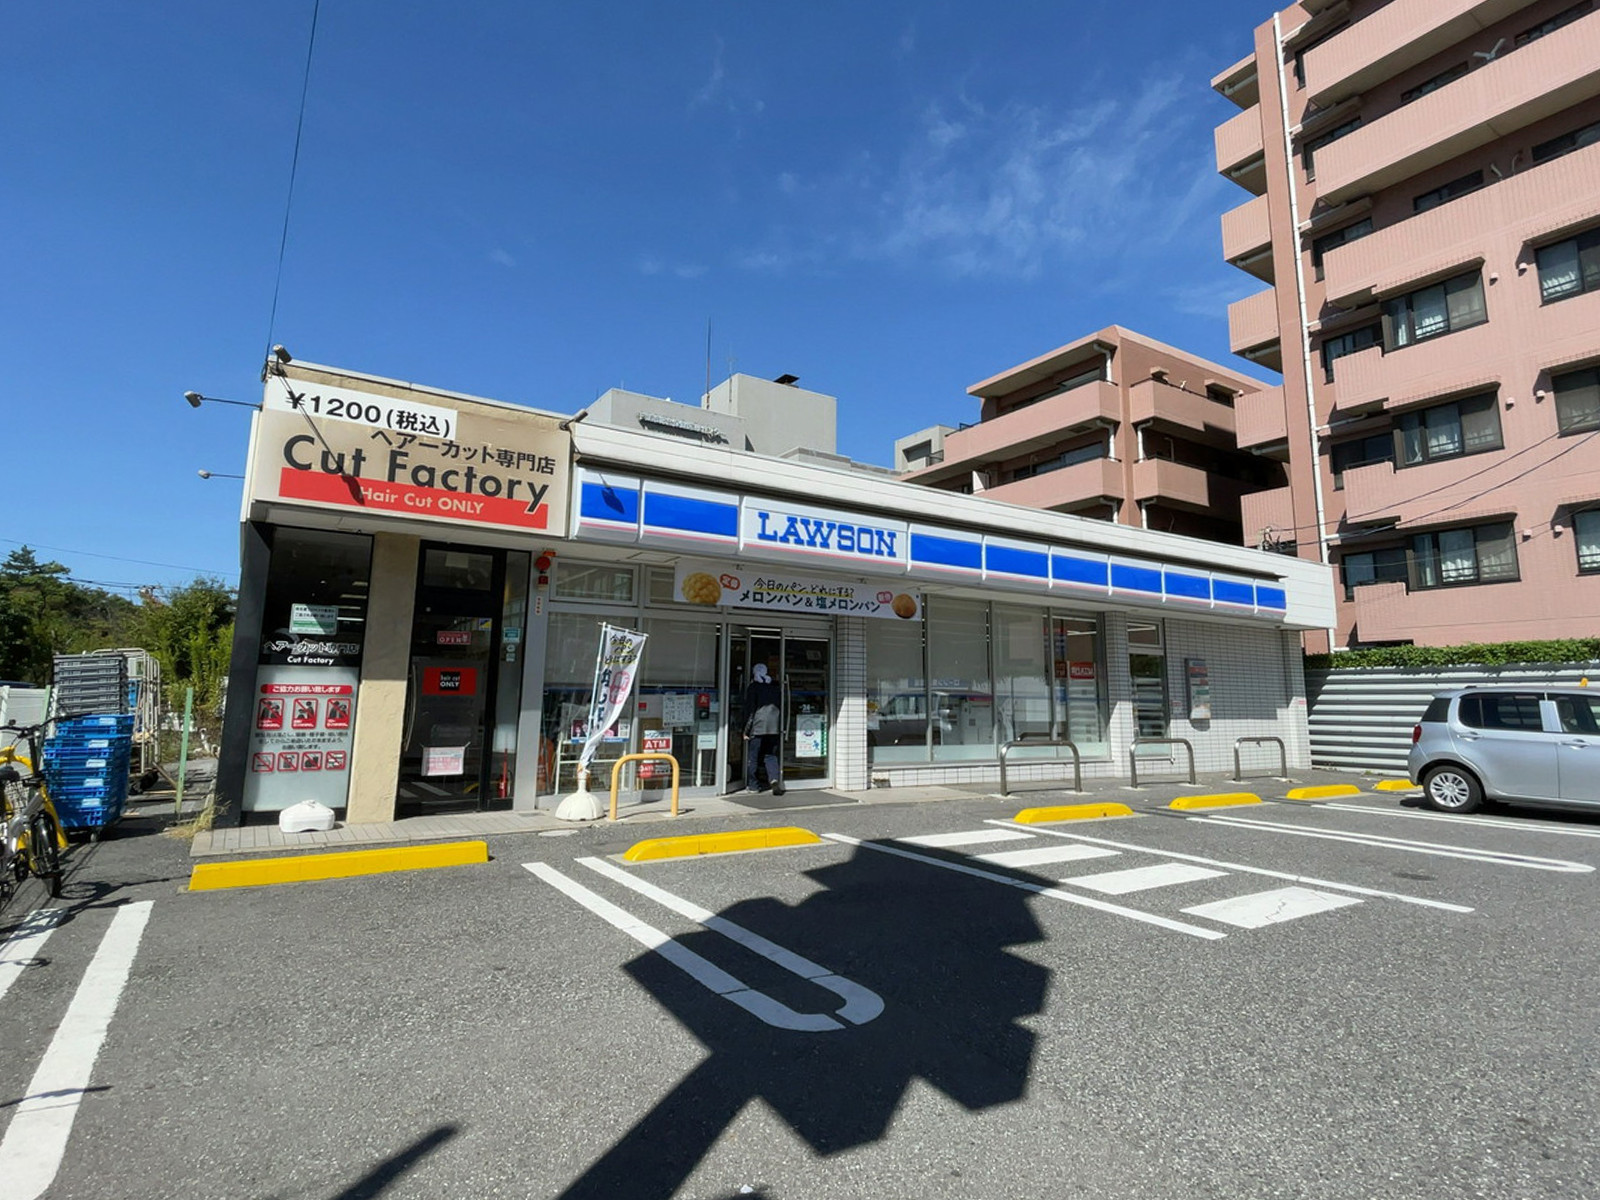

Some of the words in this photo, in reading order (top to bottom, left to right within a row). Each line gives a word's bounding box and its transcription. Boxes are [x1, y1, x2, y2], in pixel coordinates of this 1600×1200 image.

[371, 430, 556, 475] ヘアーカット専門店
[284, 434, 366, 477] Cut
[387, 449, 549, 513] Factory
[361, 487, 398, 503] Hair
[404, 493, 433, 509] Cut
[438, 498, 485, 515] ONLY
[757, 512, 896, 557] LAWSON
[287, 655, 303, 664] Cut
[303, 656, 335, 666] Factory
[645, 740, 667, 749] ATM
